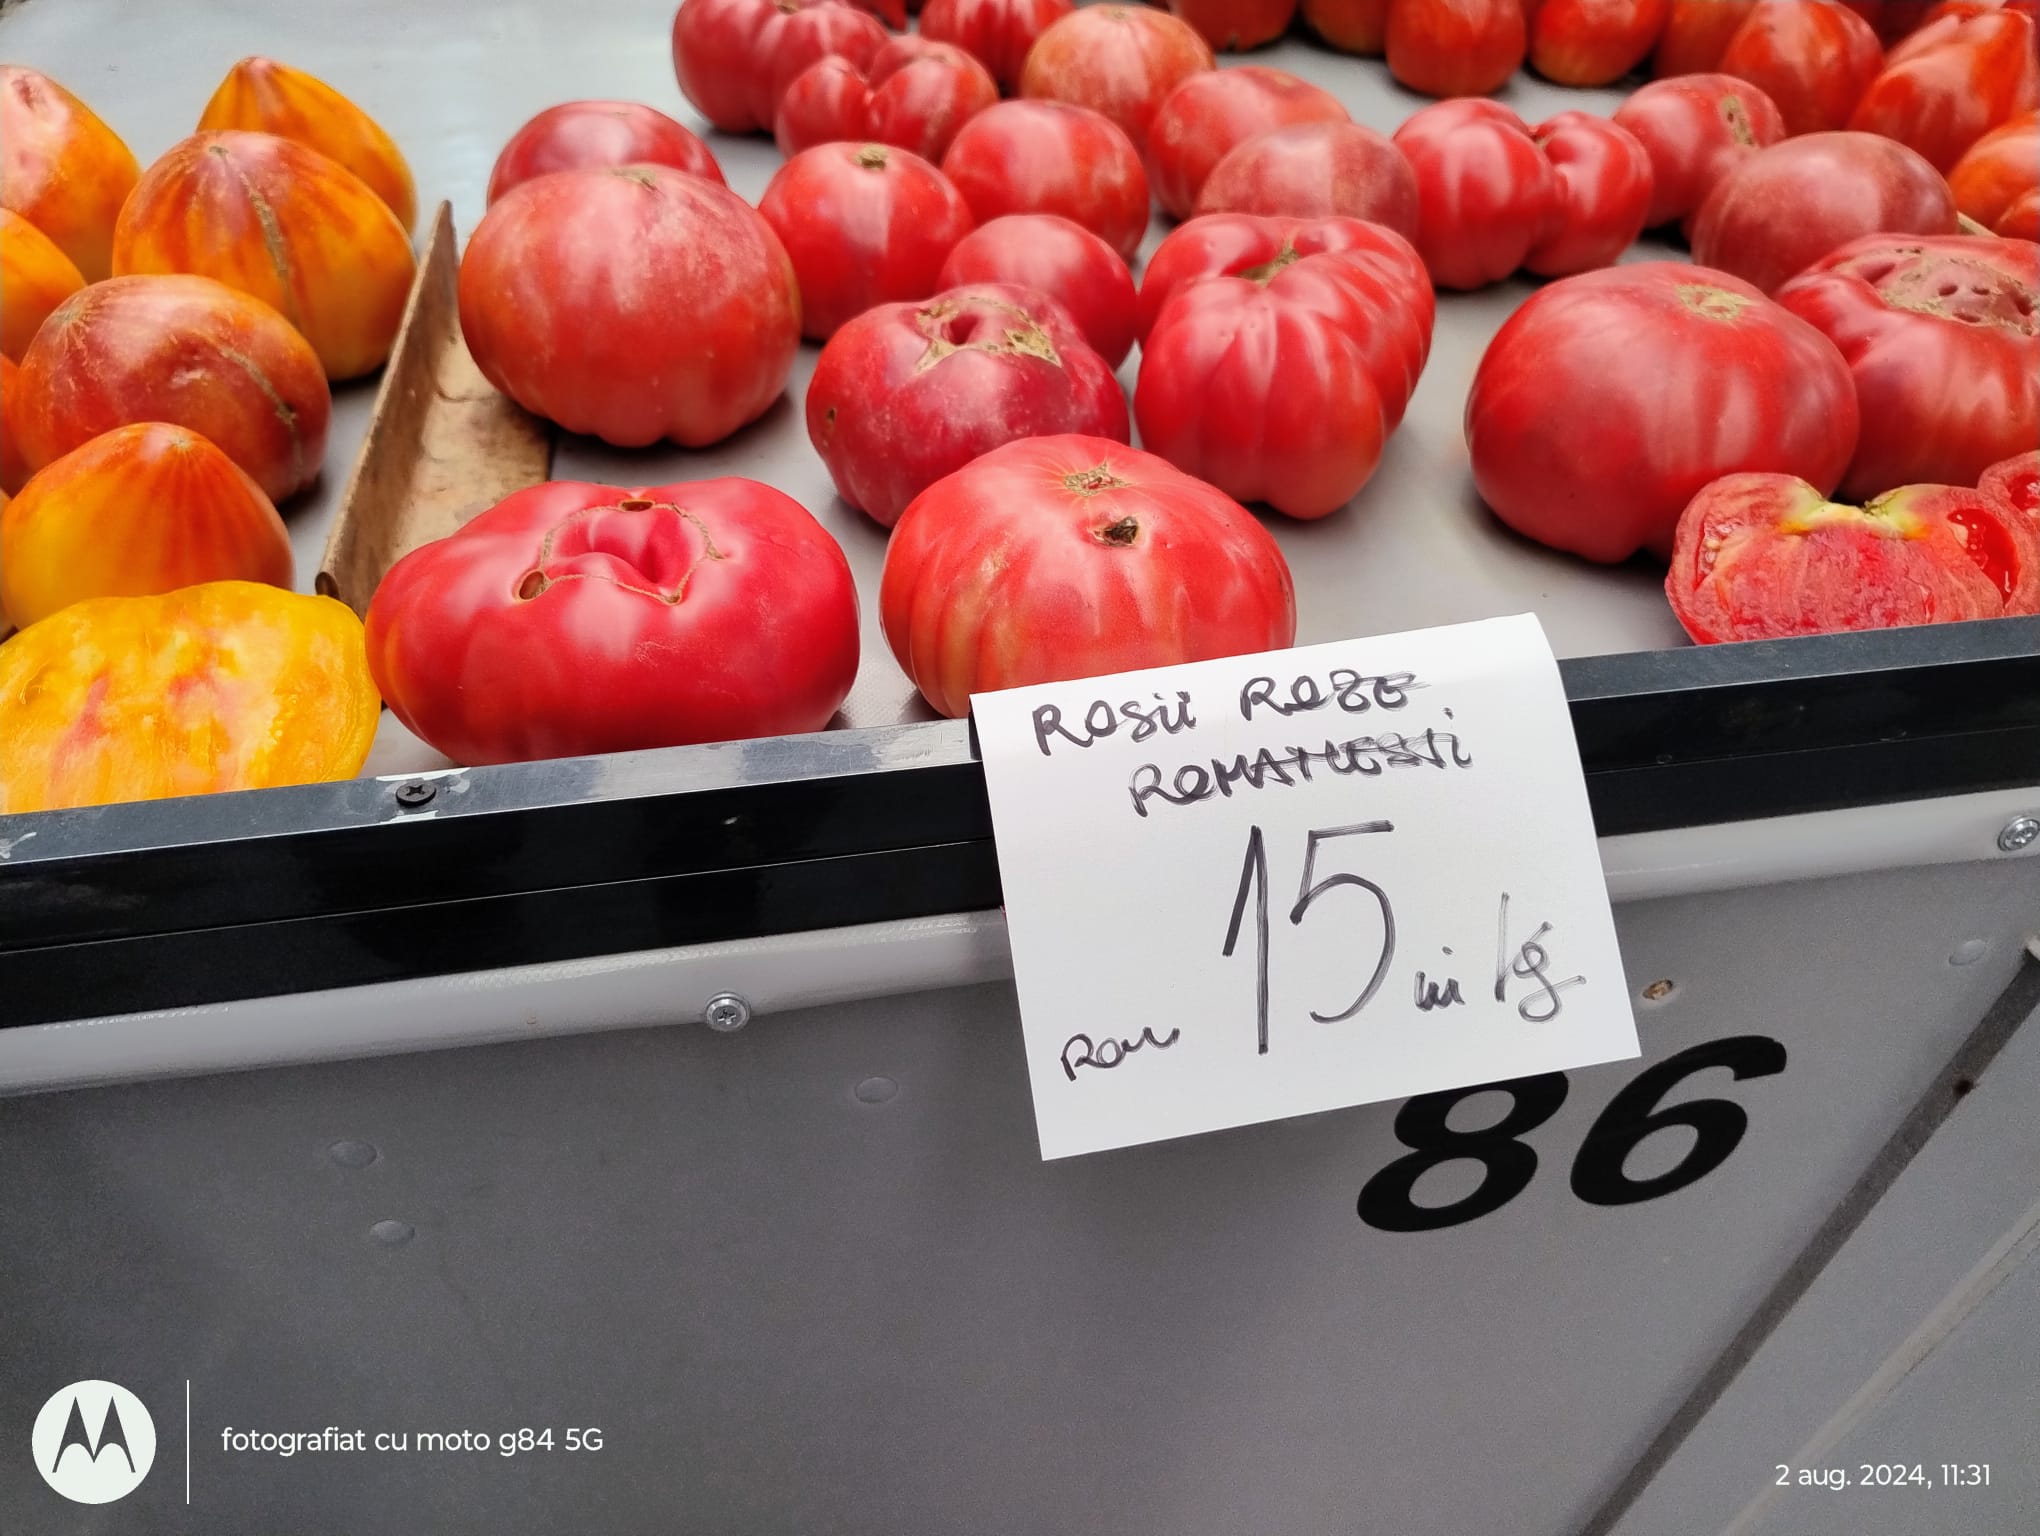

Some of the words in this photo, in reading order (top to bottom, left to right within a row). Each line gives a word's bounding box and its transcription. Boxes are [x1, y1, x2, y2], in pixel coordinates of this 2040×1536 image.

[1222, 820, 1395, 1055] 15
[1494, 893, 1585, 1022] kg
[1357, 1035, 1787, 1232] 86
